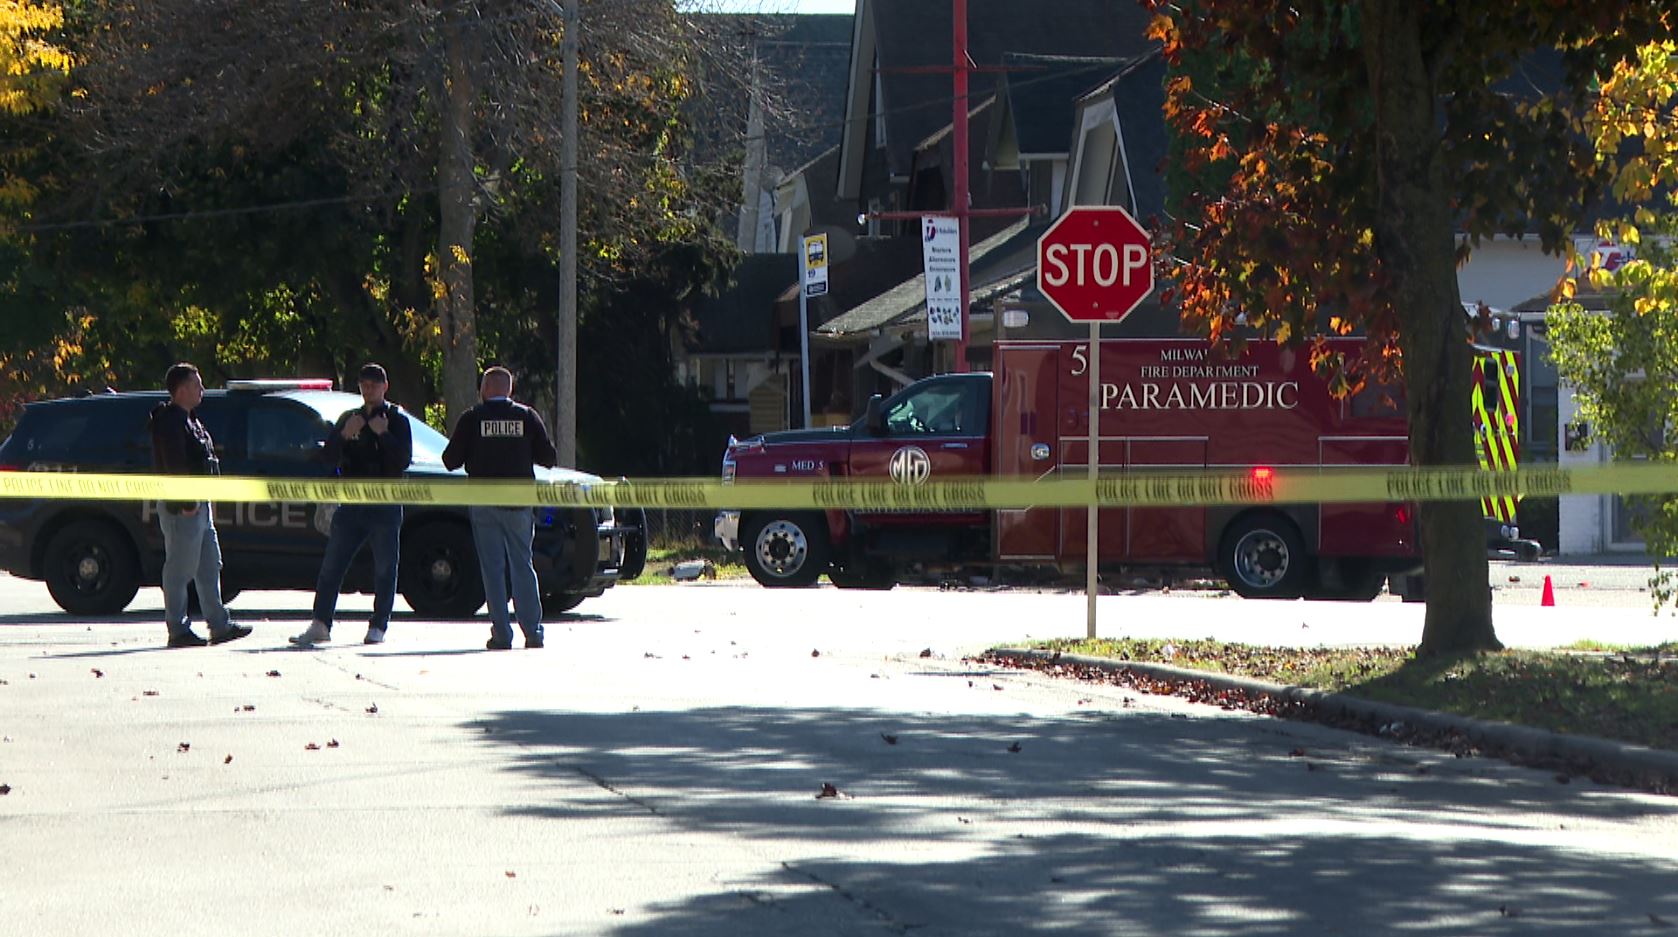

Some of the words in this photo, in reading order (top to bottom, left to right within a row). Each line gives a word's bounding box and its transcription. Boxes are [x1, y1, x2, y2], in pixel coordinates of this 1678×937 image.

[1045, 243, 1147, 287] STOP
[1071, 345, 1087, 376] 5
[1160, 349, 1209, 361] MILWA
[1141, 366, 1169, 378] FIRE
[1172, 365, 1259, 378] DEPARTMENT
[1101, 382, 1299, 410] PARAMEDIC
[484, 421, 521, 436] POLICE
[792, 460, 815, 470] MED
[819, 460, 825, 470] 5
[894, 447, 926, 486] MFD
[3, 477, 43, 492] POLICE
[49, 478, 73, 493] LINE
[98, 479, 121, 494] NOT
[267, 482, 309, 499] POLICE
[312, 482, 338, 499] LINE
[343, 482, 361, 500] DO
[363, 483, 388, 500] NOT
[536, 482, 579, 502] POLICE
[812, 482, 855, 504] POLICE
[861, 482, 888, 504] LINE
[892, 482, 911, 504] DO
[913, 481, 939, 503] NOT
[943, 481, 986, 503] CROSS
[1387, 473, 1432, 496] POLICE
[141, 498, 307, 528] PLICE
